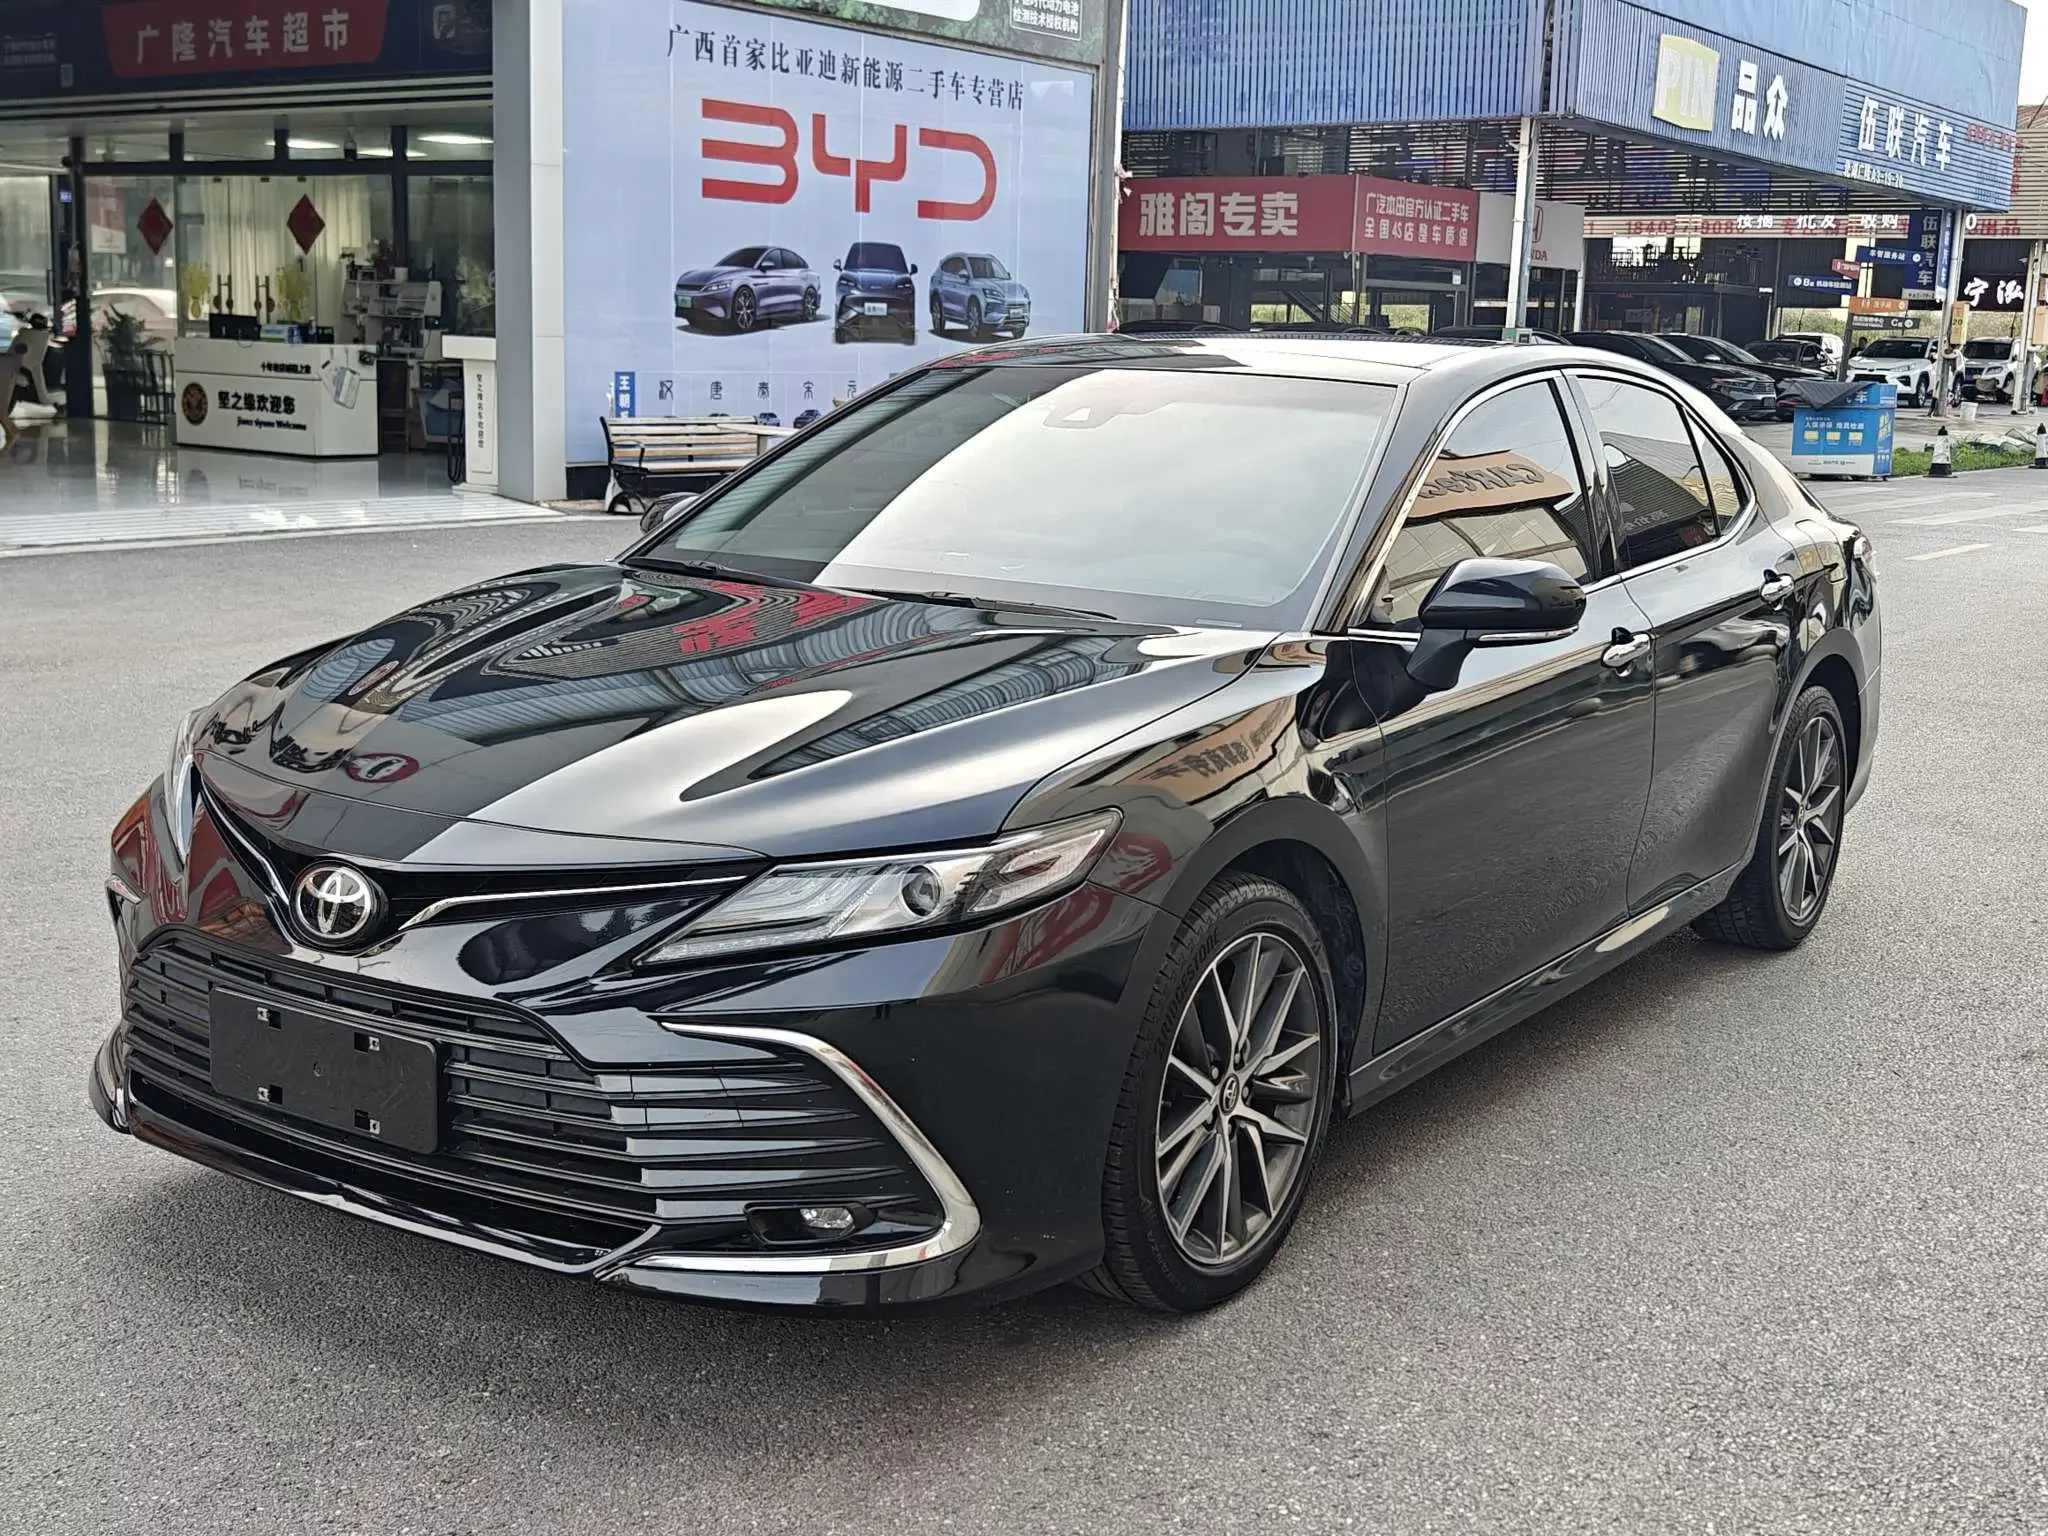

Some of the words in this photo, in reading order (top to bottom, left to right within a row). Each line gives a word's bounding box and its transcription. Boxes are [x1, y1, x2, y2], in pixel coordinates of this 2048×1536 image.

[137, 8, 350, 64] 广隆汽车超市
[666, 24, 1025, 112] 广西首家比亚迪新能源二手车专营店
[1656, 44, 1719, 124] PIN
[1731, 59, 1789, 141] 品众
[702, 98, 997, 221] BYD
[1858, 96, 1954, 172] 伍联汽车
[1139, 191, 1299, 238] 雅阁专卖
[1365, 192, 1470, 223] 广汽本田官方认证二手车
[710, 380, 722, 400] 唐
